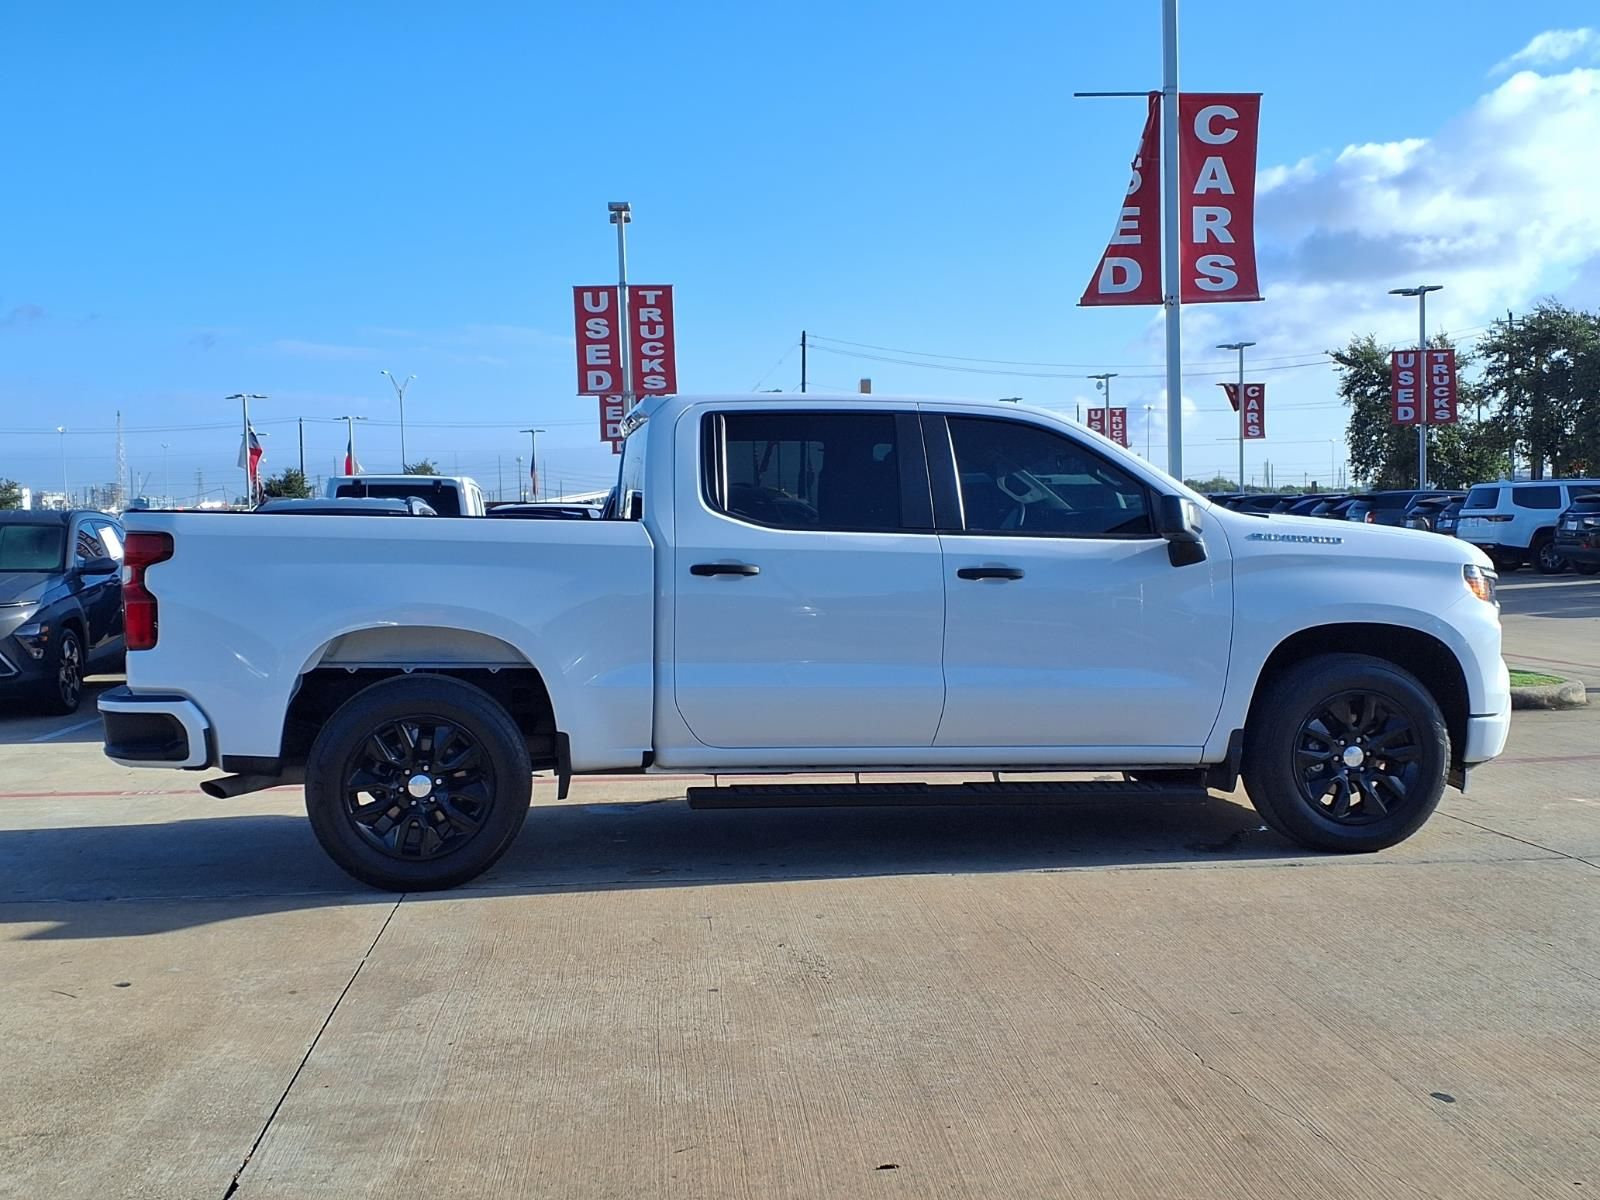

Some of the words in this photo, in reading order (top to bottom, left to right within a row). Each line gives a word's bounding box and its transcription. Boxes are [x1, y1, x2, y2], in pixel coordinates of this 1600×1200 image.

[1098, 139, 1143, 294] ED
[1193, 105, 1238, 291] CARS
[583, 291, 612, 391] USED
[638, 291, 666, 390] TRUCKS
[605, 395, 623, 438] SED
[1247, 386, 1260, 436] CARS
[1397, 353, 1414, 420] USED
[1433, 352, 1450, 420] TRUCKS
[1090, 410, 1102, 430] US
[1112, 409, 1123, 444] TRUCK
